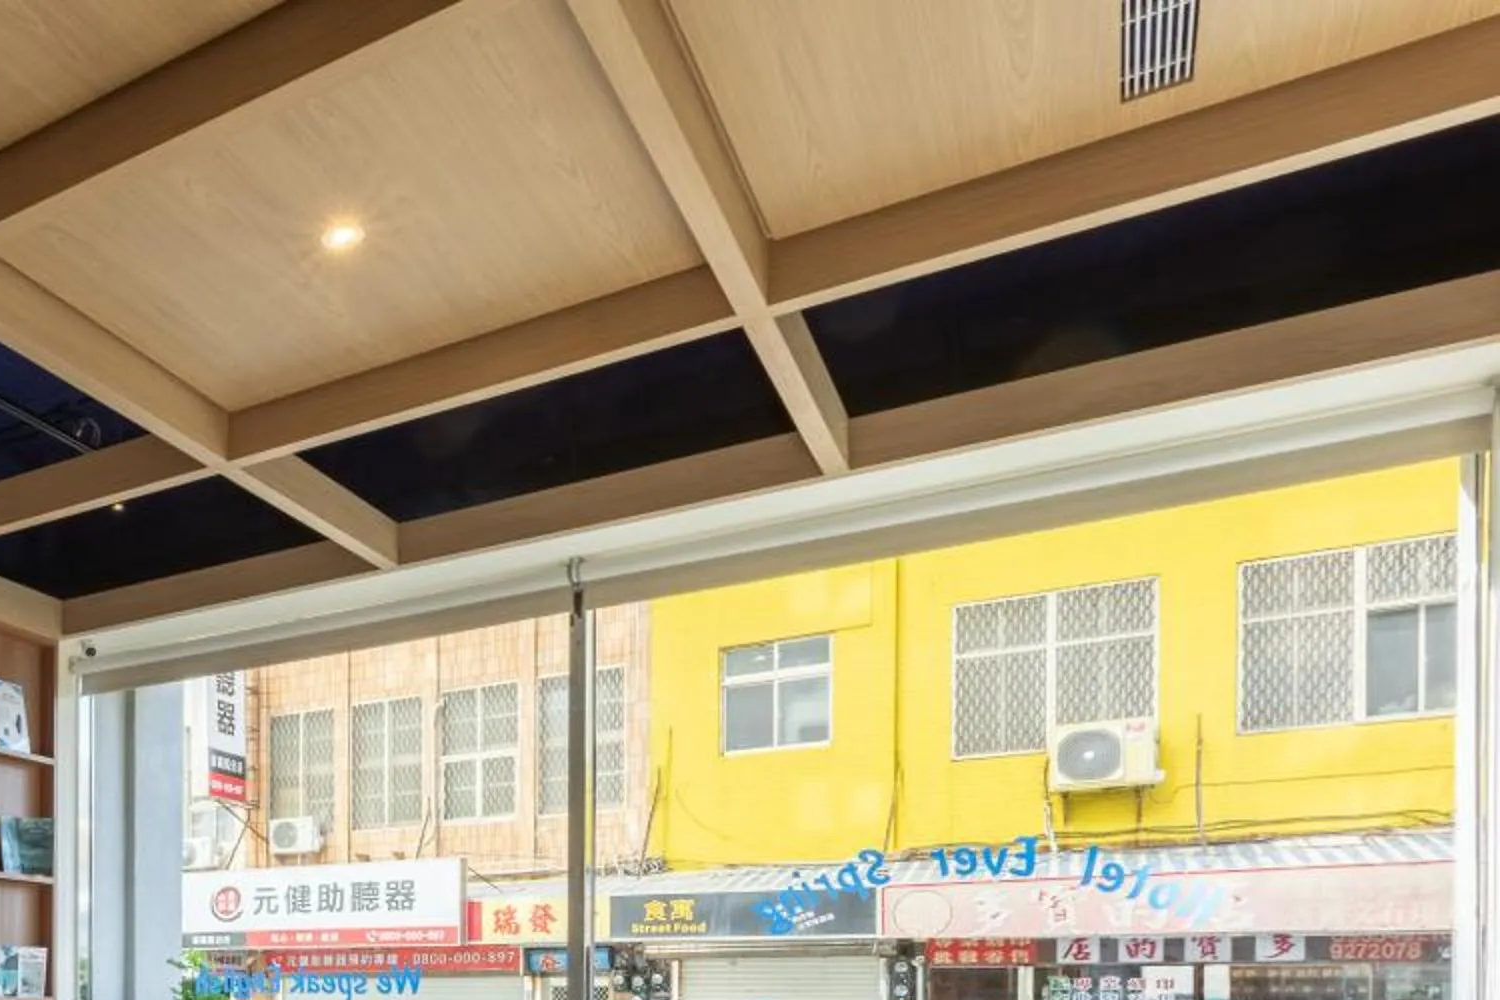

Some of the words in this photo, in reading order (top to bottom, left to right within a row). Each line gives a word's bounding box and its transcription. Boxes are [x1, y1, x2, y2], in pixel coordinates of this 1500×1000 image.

[252, 880, 417, 916] 元健助聽器
